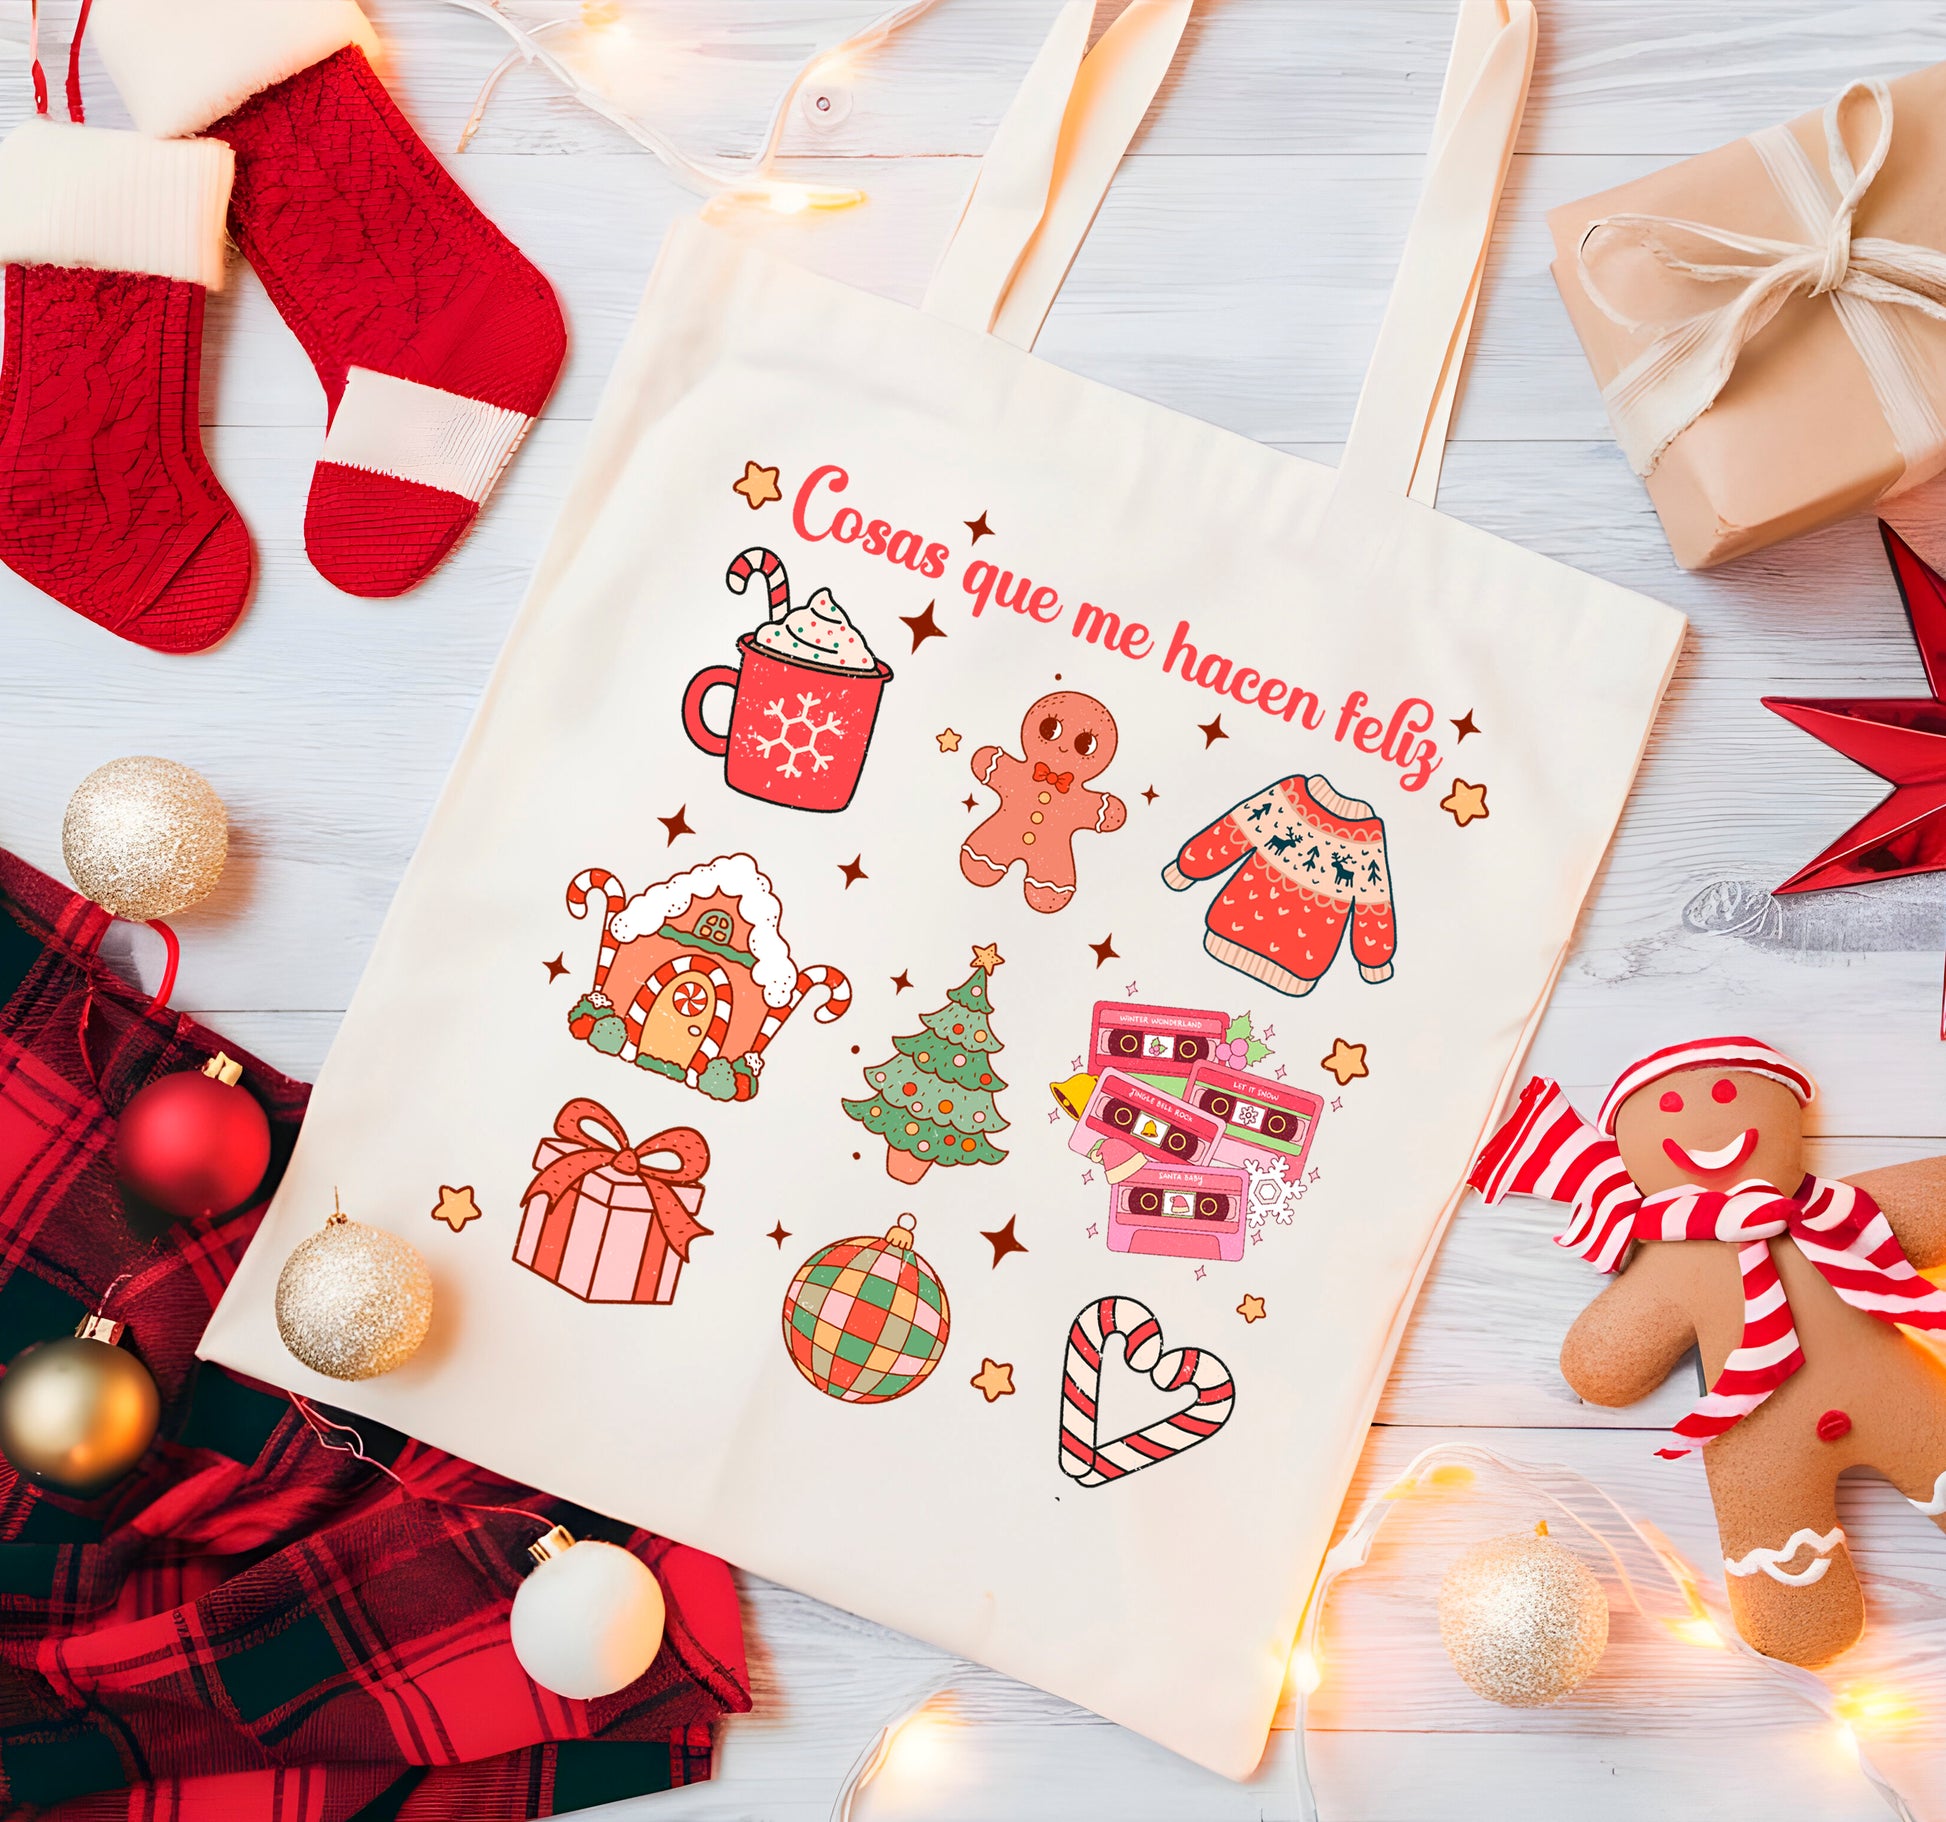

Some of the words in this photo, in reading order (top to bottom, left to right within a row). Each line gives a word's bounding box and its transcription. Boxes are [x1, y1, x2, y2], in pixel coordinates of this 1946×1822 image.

[792, 464, 949, 579] Cosas
[962, 560, 1063, 624] que
[1071, 602, 1155, 660] me
[1162, 620, 1325, 732] hacen
[1334, 690, 1443, 792] feliz
[1151, 1017, 1203, 1029] WONDERLAND
[1233, 1081, 1248, 1091] LET
[1257, 1088, 1280, 1102] SNOW
[1129, 1088, 1156, 1105] JINGLE
[1157, 1100, 1172, 1113] BELL
[1174, 1108, 1193, 1123] ROCK
[1158, 1172, 1182, 1181] SANTA
